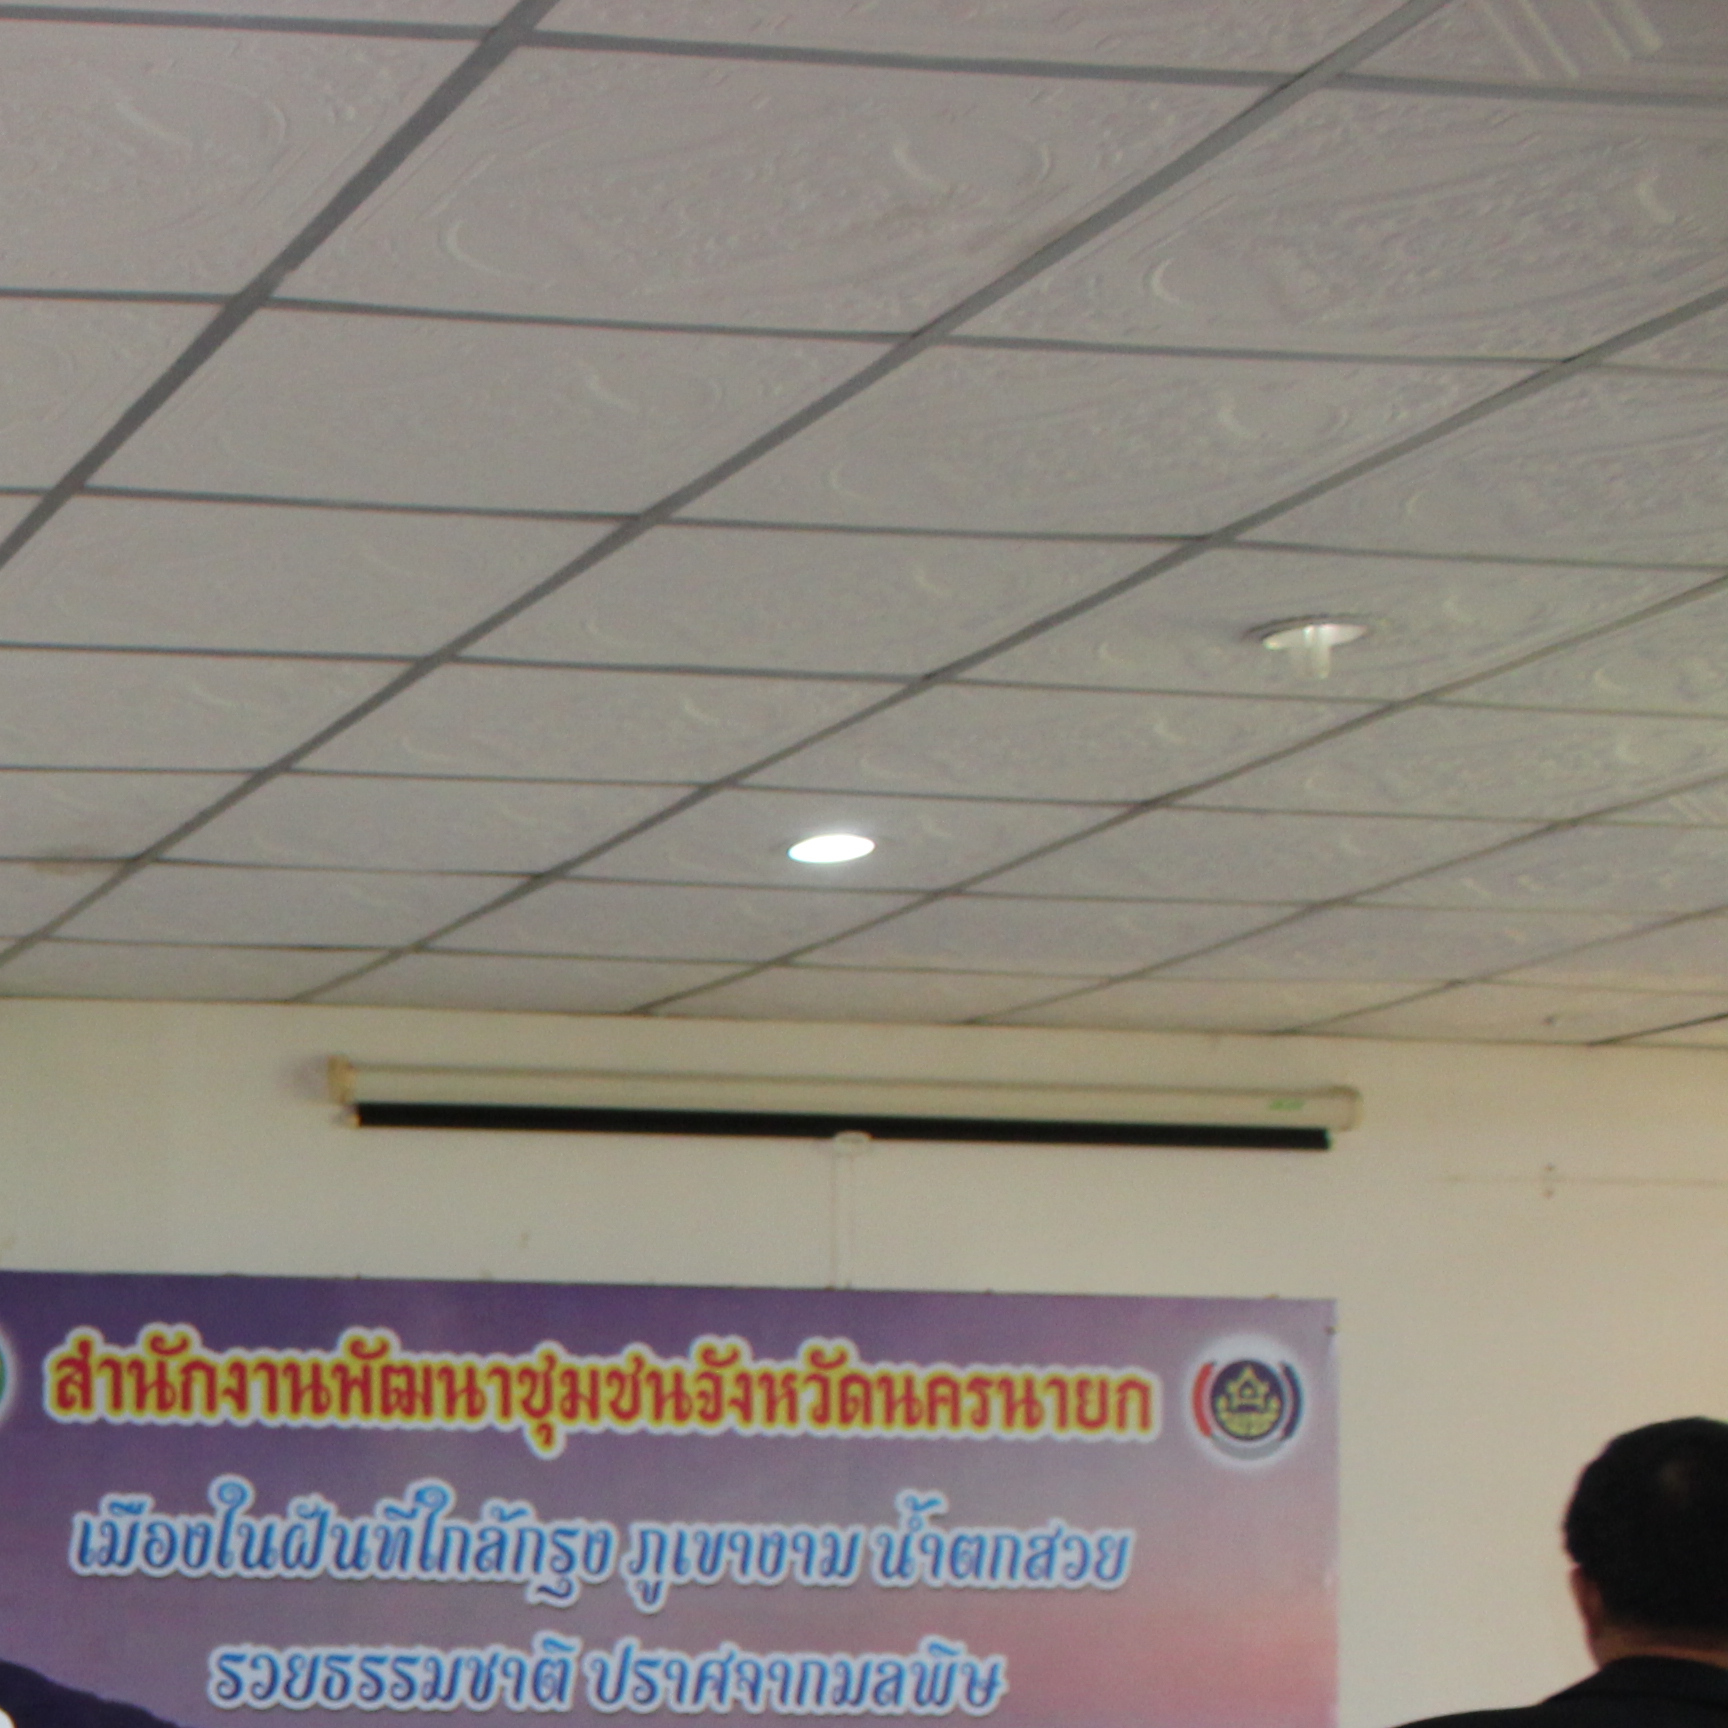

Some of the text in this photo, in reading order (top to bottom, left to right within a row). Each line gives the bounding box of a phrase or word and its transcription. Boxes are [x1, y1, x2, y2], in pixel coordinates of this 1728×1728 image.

[52, 1333, 1155, 1450] สำนักงานพัฒนาชุมชนจังหวัดนครนายก
[628, 1522, 860, 1608] ภูเขางาม
[874, 1492, 1132, 1586] น้ำตกสวย
[215, 1637, 1003, 1712] รวยธรรมชาติ ปราศจากมลพิษ
